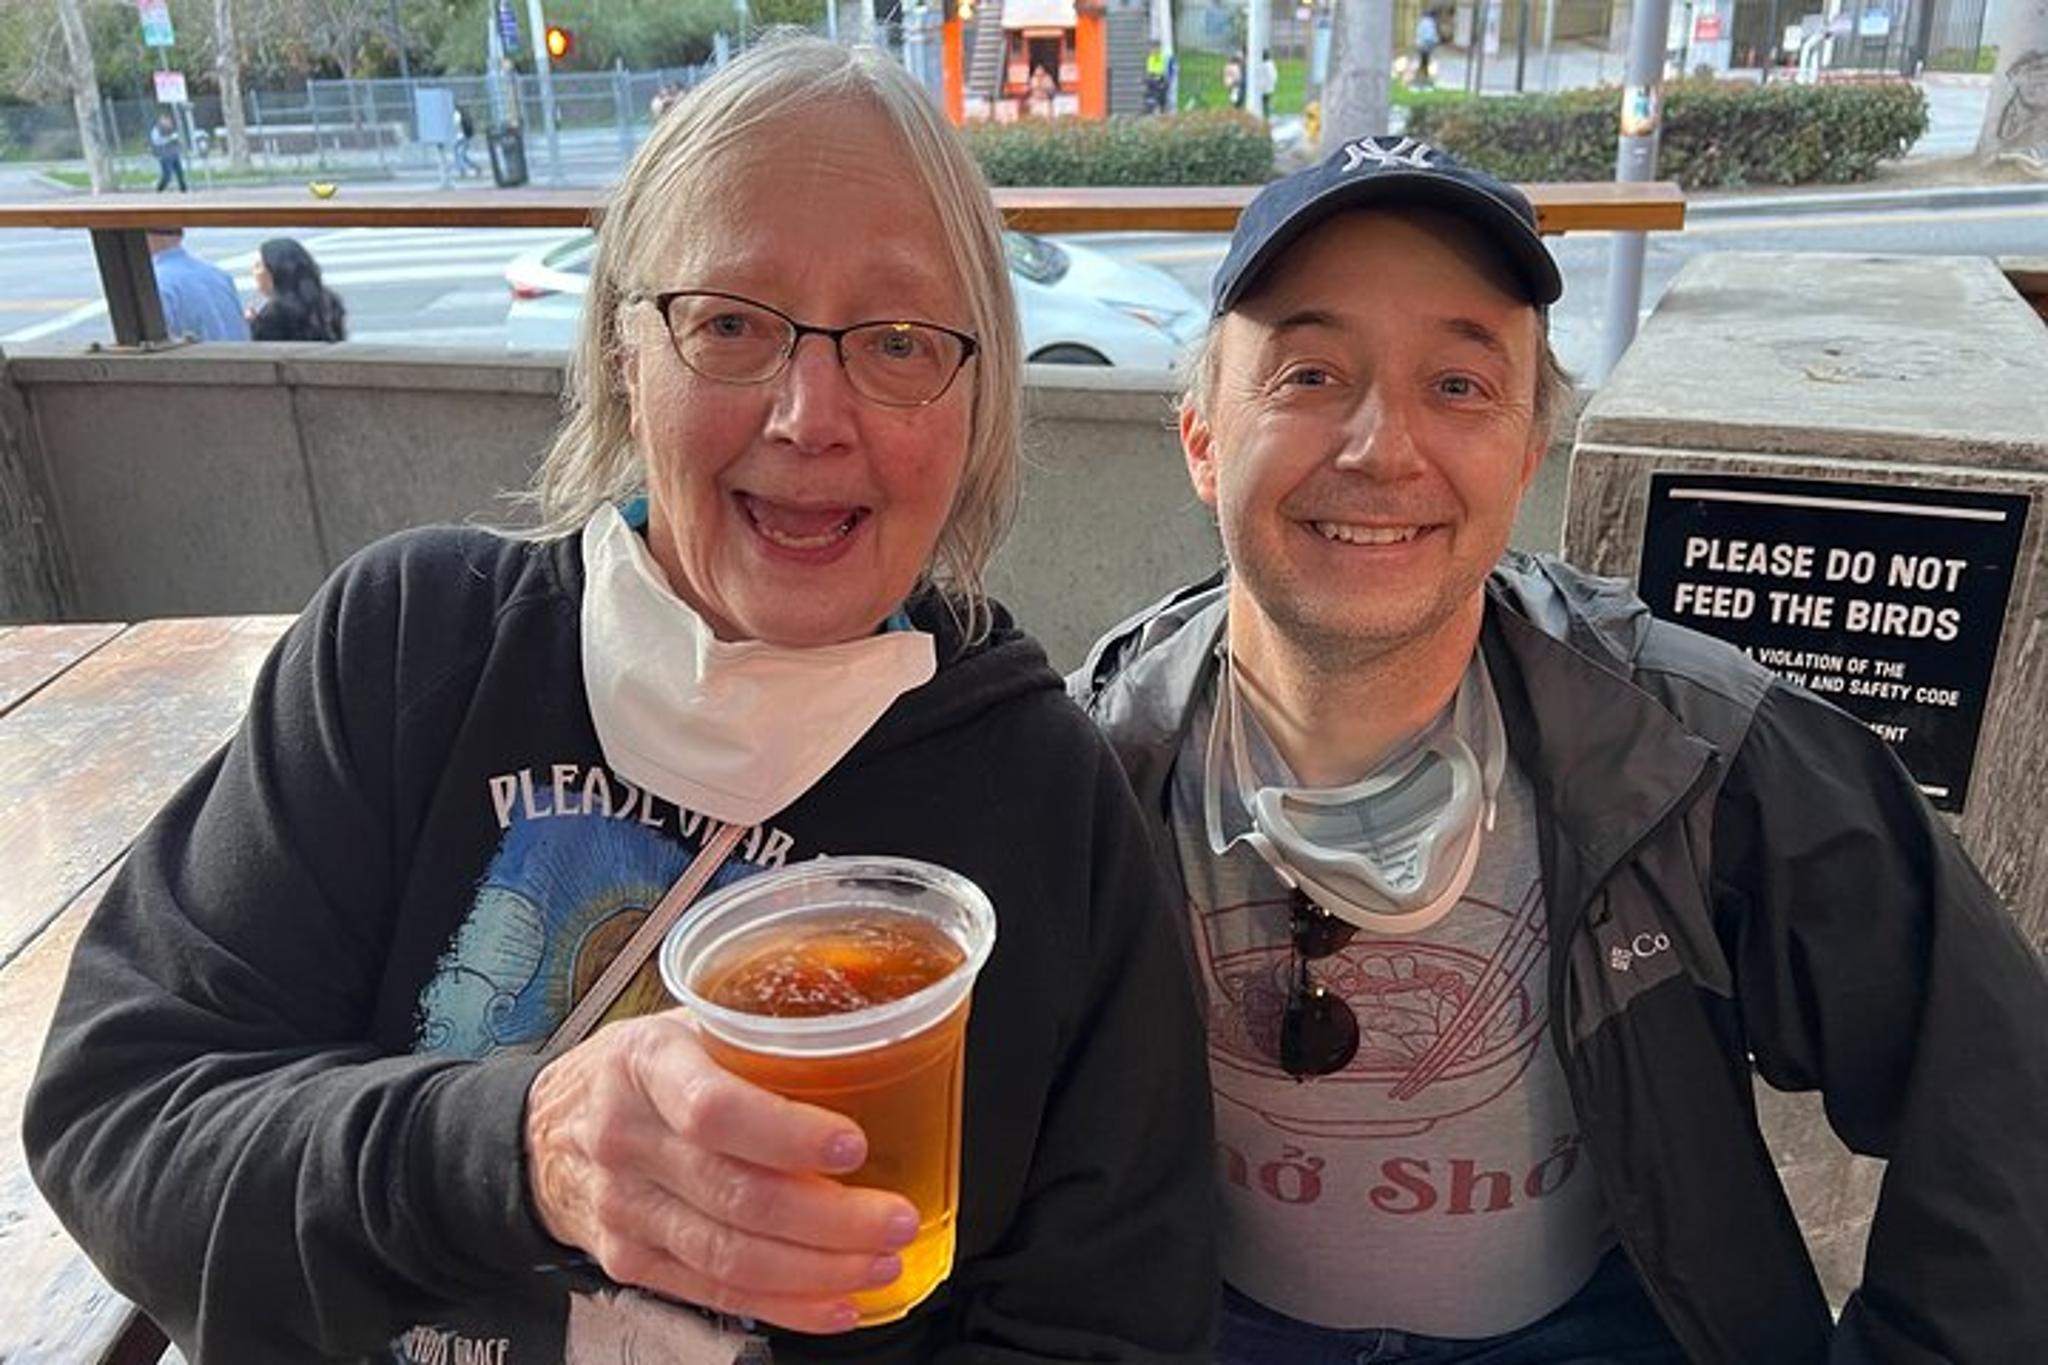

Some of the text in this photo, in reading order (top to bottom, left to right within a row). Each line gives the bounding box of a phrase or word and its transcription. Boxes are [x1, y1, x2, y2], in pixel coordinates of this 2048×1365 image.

[1342, 137, 1434, 172] NY
[1684, 536, 1967, 592] PLEASE DO NOT
[1673, 582, 1961, 642] FEED THE BIRDS
[1759, 647, 1843, 671] VIOLATION
[1847, 658, 1868, 675] OF
[1873, 660, 1906, 680] THE
[1810, 674, 1844, 693] AND
[1849, 679, 1912, 702] SAFETY
[1915, 687, 1960, 707] CODE
